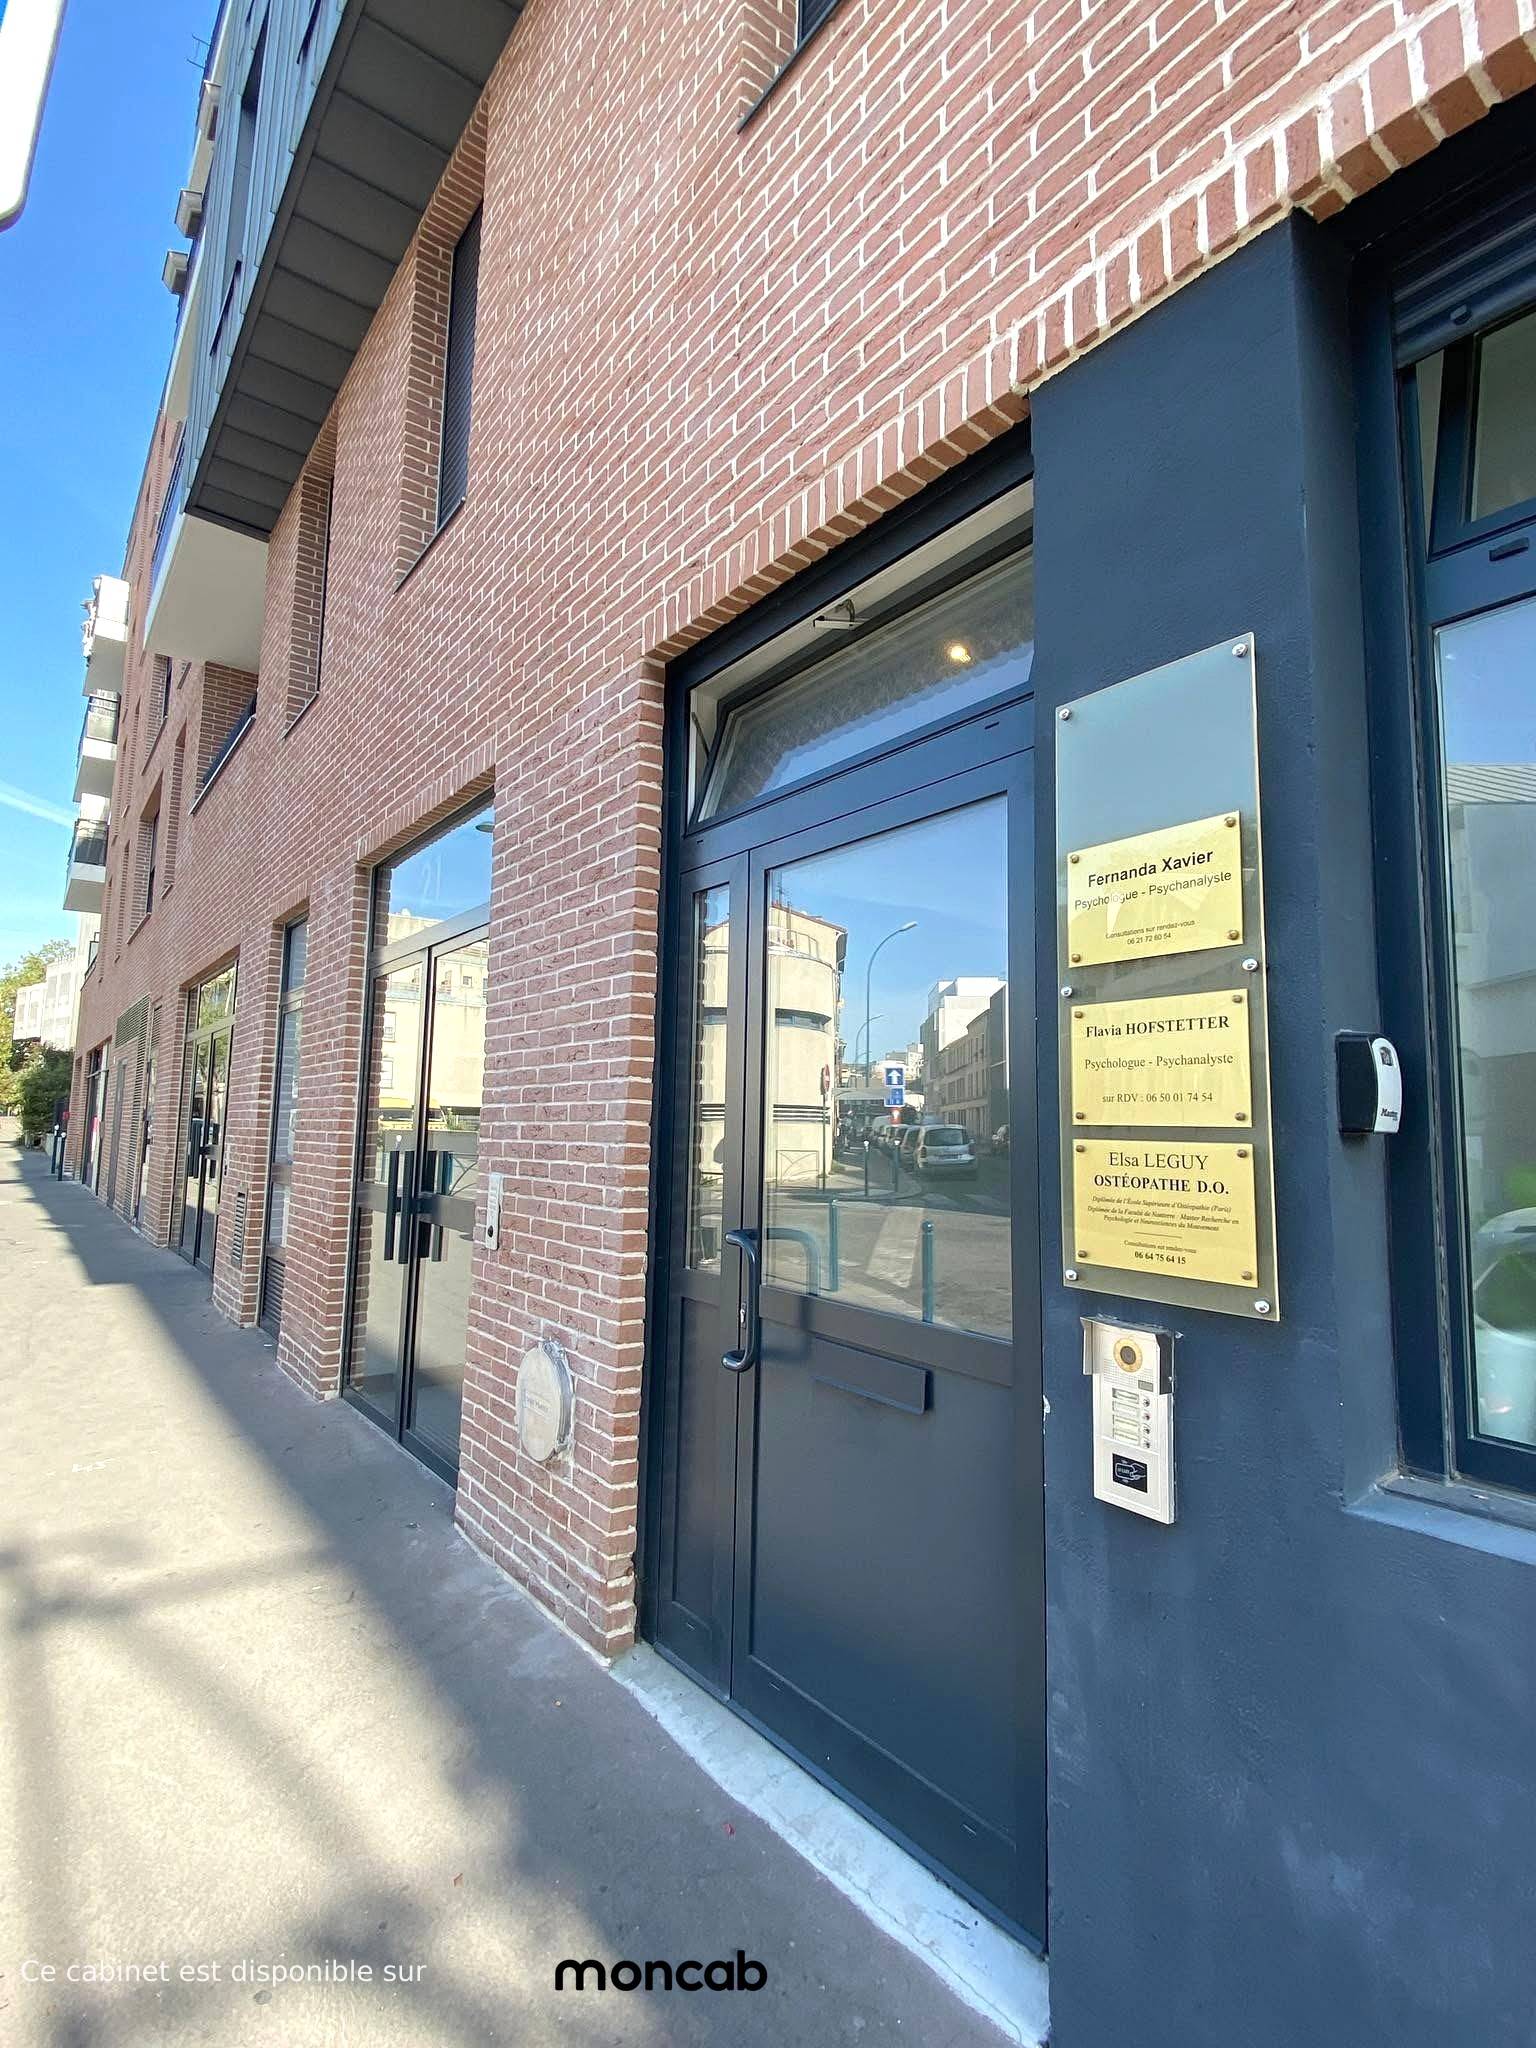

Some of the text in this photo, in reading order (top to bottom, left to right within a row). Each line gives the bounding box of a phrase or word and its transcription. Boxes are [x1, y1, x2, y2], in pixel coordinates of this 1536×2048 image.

[1088, 851, 1213, 887] Fernanda Xavier
[1149, 870, 1232, 895] Psychanalyste
[1136, 936, 1143, 944] 21
[1086, 1015, 1230, 1038] Flavia HOFSTETTER
[1085, 1057, 1146, 1071] Psychologue
[1156, 1053, 1233, 1069] Psychanalyste
[1102, 1095, 1114, 1103] sur
[1117, 1093, 1139, 1103] RDV
[1146, 1092, 1157, 1103] 06
[1160, 1092, 1171, 1103] 50
[1173, 1092, 1184, 1102] 01
[1188, 1092, 1198, 1102] 74
[1201, 1091, 1213, 1102] 54
[1109, 1151, 1209, 1170] Elsa LEGUY
[1094, 1172, 1230, 1195] OSTÉOPATHE D.O.
[1134, 1251, 1187, 1265] 06 64 75 64 15
